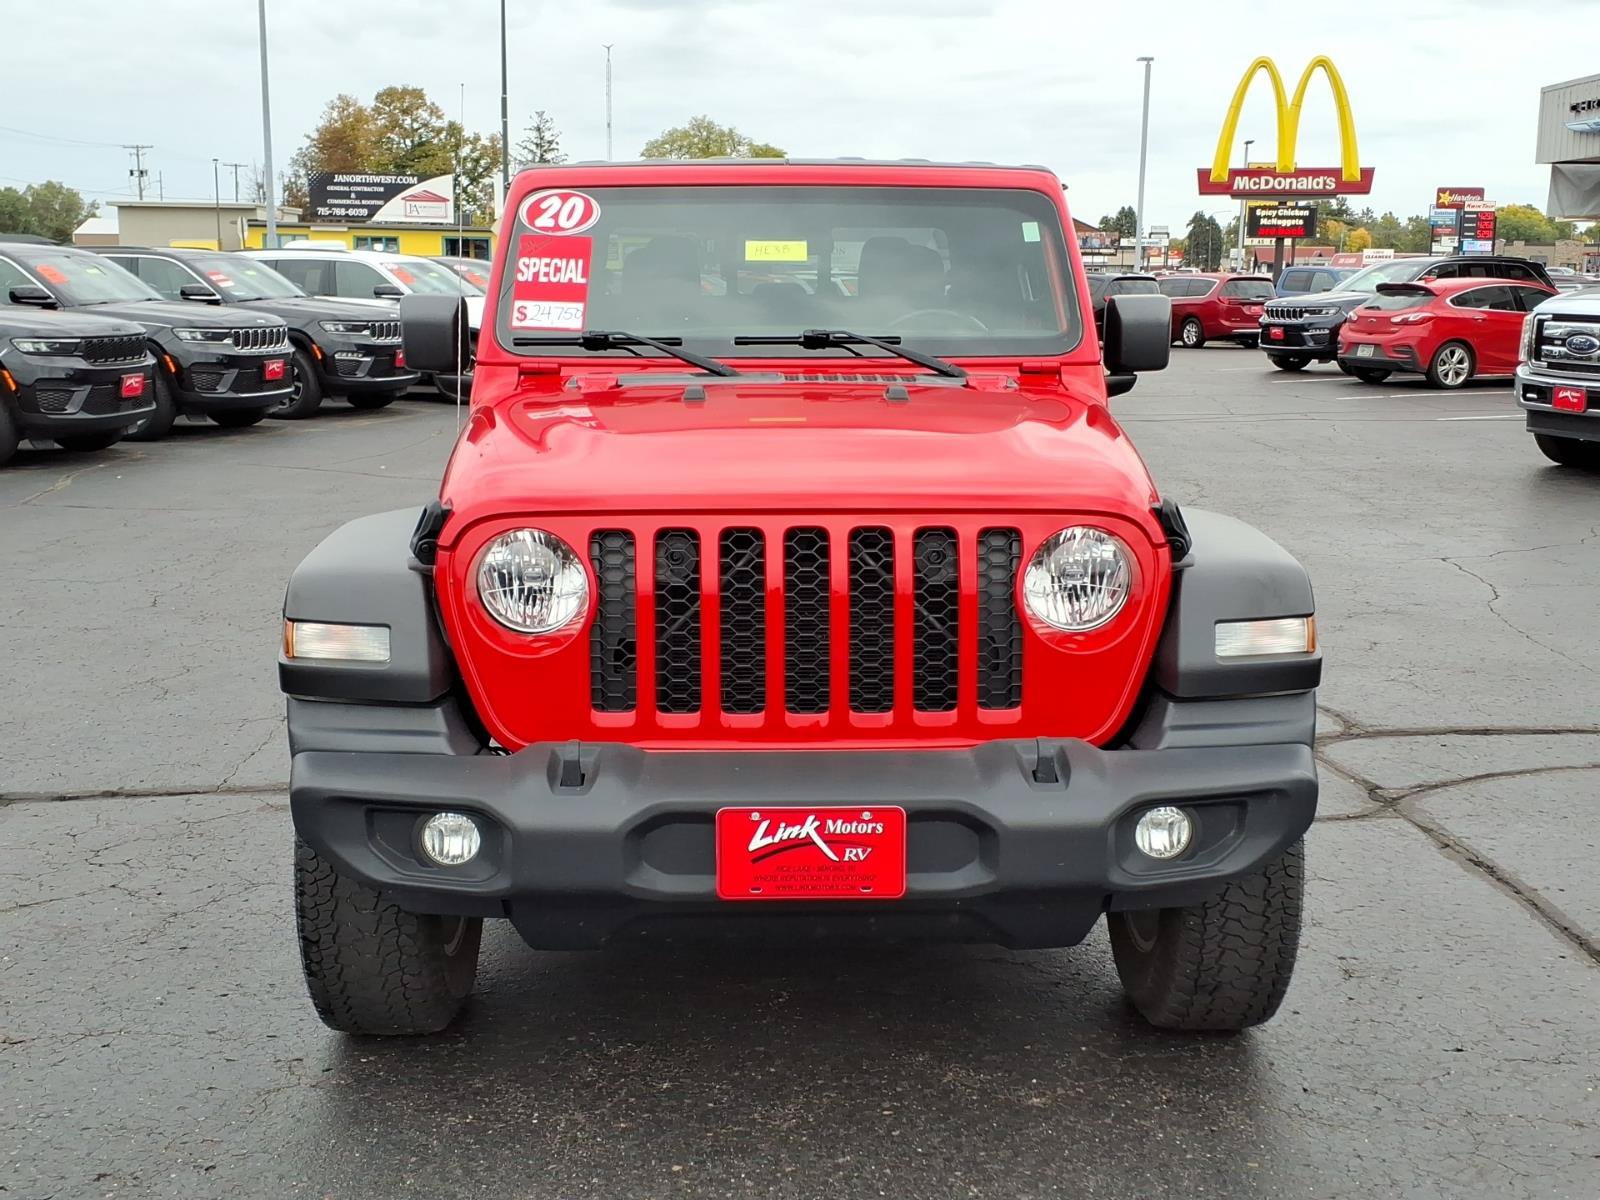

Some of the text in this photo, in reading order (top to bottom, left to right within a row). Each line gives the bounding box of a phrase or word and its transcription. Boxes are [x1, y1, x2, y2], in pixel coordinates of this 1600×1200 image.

[333, 174, 418, 184] JANORTHWEST.COM
[1233, 176, 1336, 190] McDonald's
[534, 195, 585, 229] 20
[1256, 208, 1309, 217] Spicy Chicken
[1260, 217, 1304, 227] McNuggets
[516, 256, 587, 283] SPECIAL
[748, 814, 884, 862] Link Motors
[842, 848, 872, 862] RV
